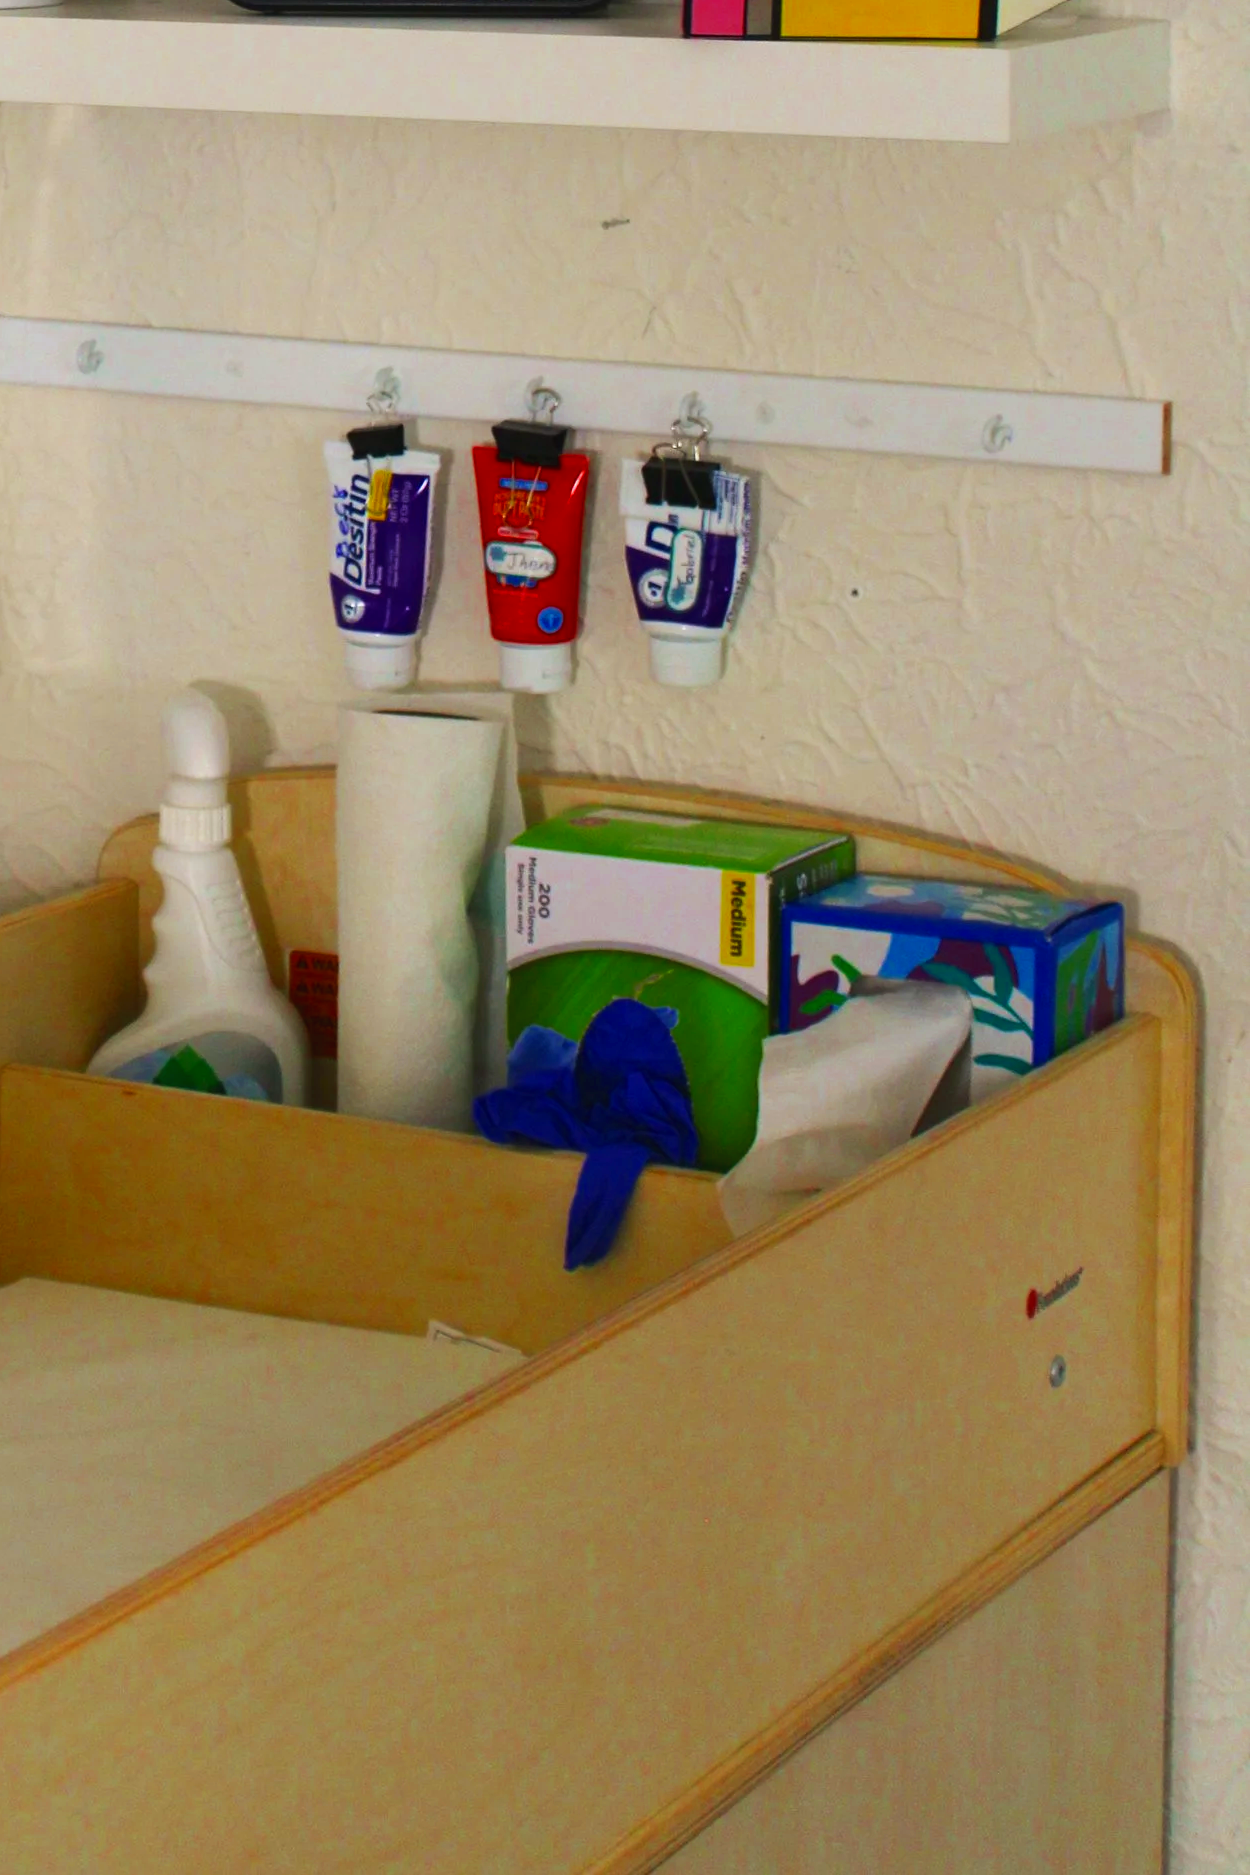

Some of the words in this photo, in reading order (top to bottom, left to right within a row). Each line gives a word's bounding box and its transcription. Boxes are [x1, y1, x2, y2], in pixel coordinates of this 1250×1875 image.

[344, 474, 370, 586] Desitin
[528, 857, 538, 906] Medium
[538, 883, 551, 919] 200
[527, 906, 536, 945] Gloves
[730, 880, 746, 958] Medium
